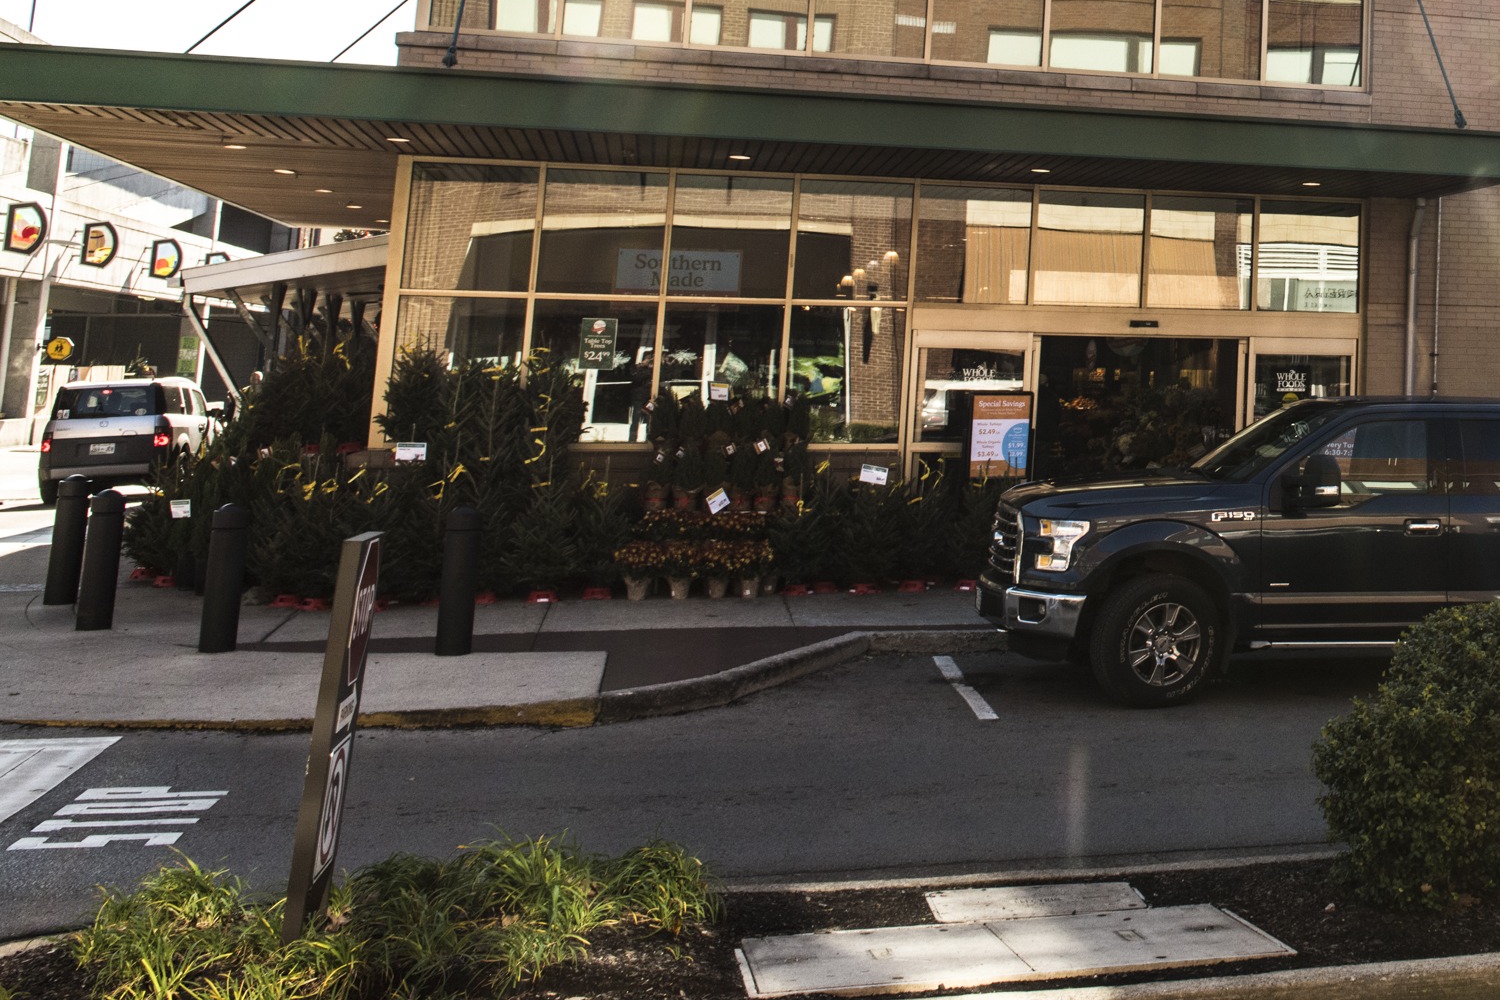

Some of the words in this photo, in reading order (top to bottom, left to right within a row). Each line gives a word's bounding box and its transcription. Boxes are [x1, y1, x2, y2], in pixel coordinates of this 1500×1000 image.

[634, 252, 722, 272] Sothern
[963, 365, 996, 377] WHOLE
[1276, 369, 1307, 381] WHOLE
[1277, 380, 1306, 388] FOODS
[352, 583, 376, 640] STOP
[6, 785, 230, 851] STOP
